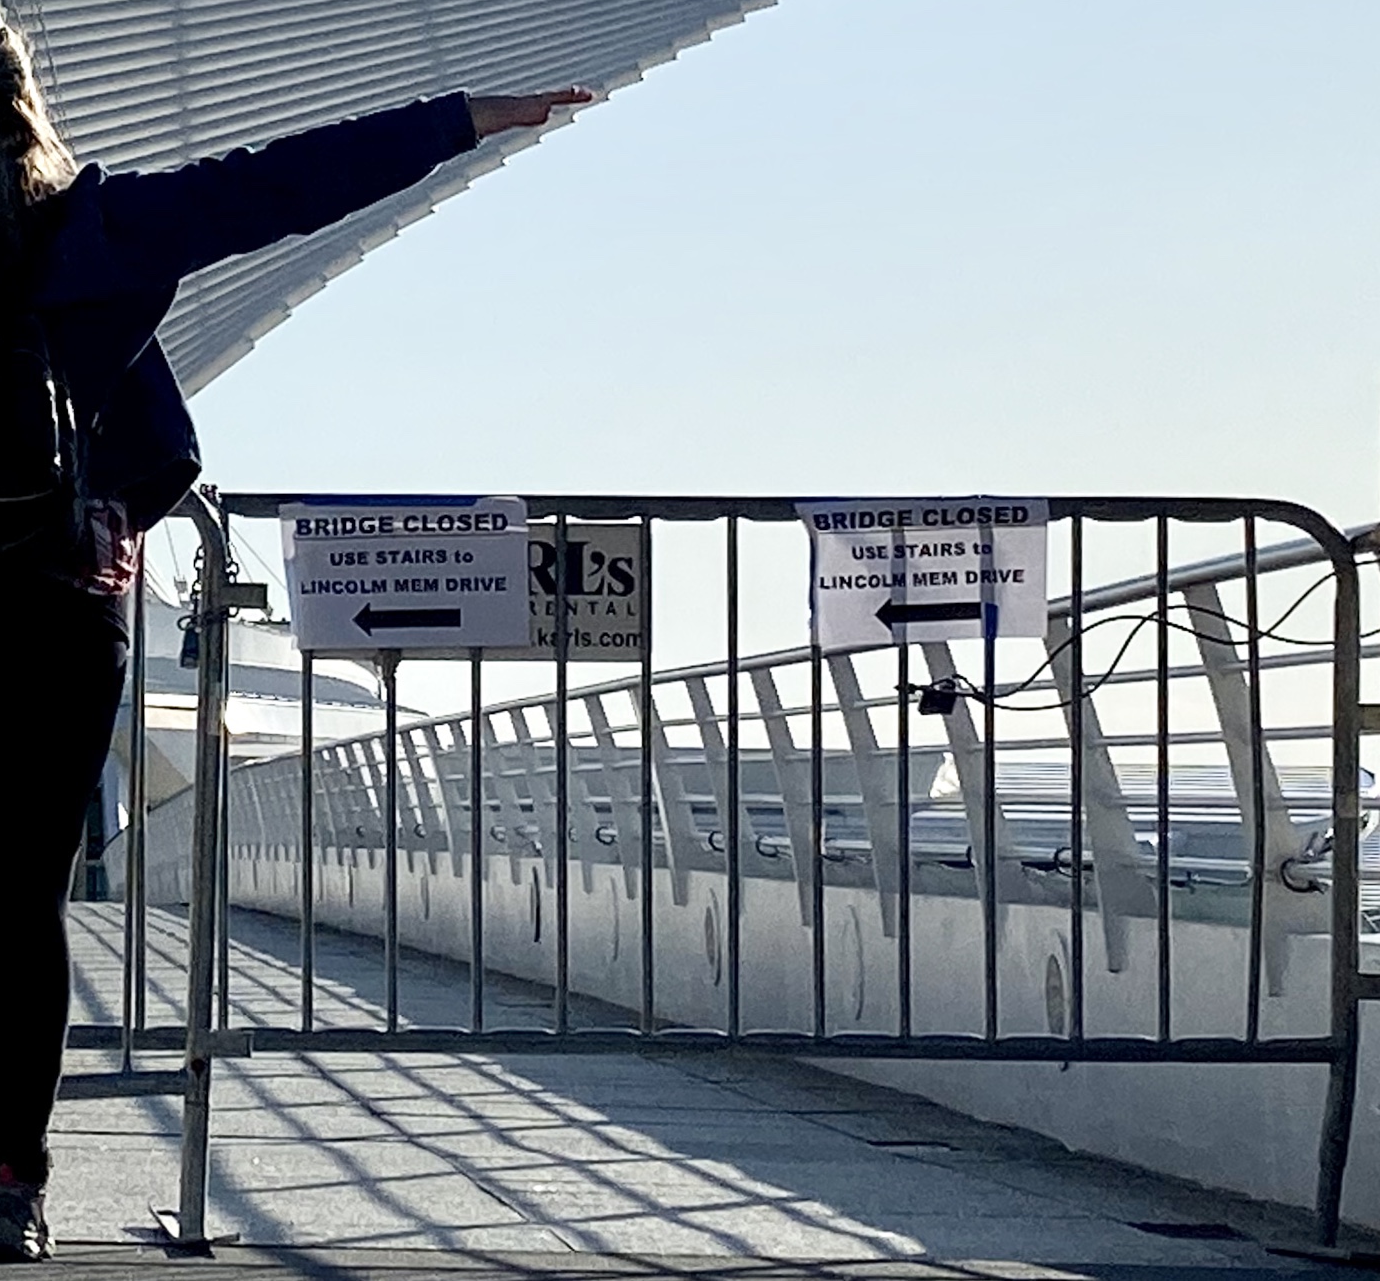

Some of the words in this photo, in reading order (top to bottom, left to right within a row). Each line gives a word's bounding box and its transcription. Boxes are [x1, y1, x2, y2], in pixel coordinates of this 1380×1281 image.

[295, 516, 394, 536] BRIDGE
[403, 513, 509, 533] CLOSED
[813, 509, 913, 531] BRIDGE
[922, 506, 1029, 526] CLOSED
[329, 551, 368, 566] USE
[376, 549, 447, 565] STAIRS
[454, 550, 474, 564] to
[852, 545, 888, 560] USE
[893, 542, 966, 559] STAIRS
[973, 542, 992, 555] to
[394, 578, 439, 593] MEM
[445, 576, 507, 592] DRIVE
[912, 571, 958, 587] MEM
[965, 569, 1025, 585] DRIVE
